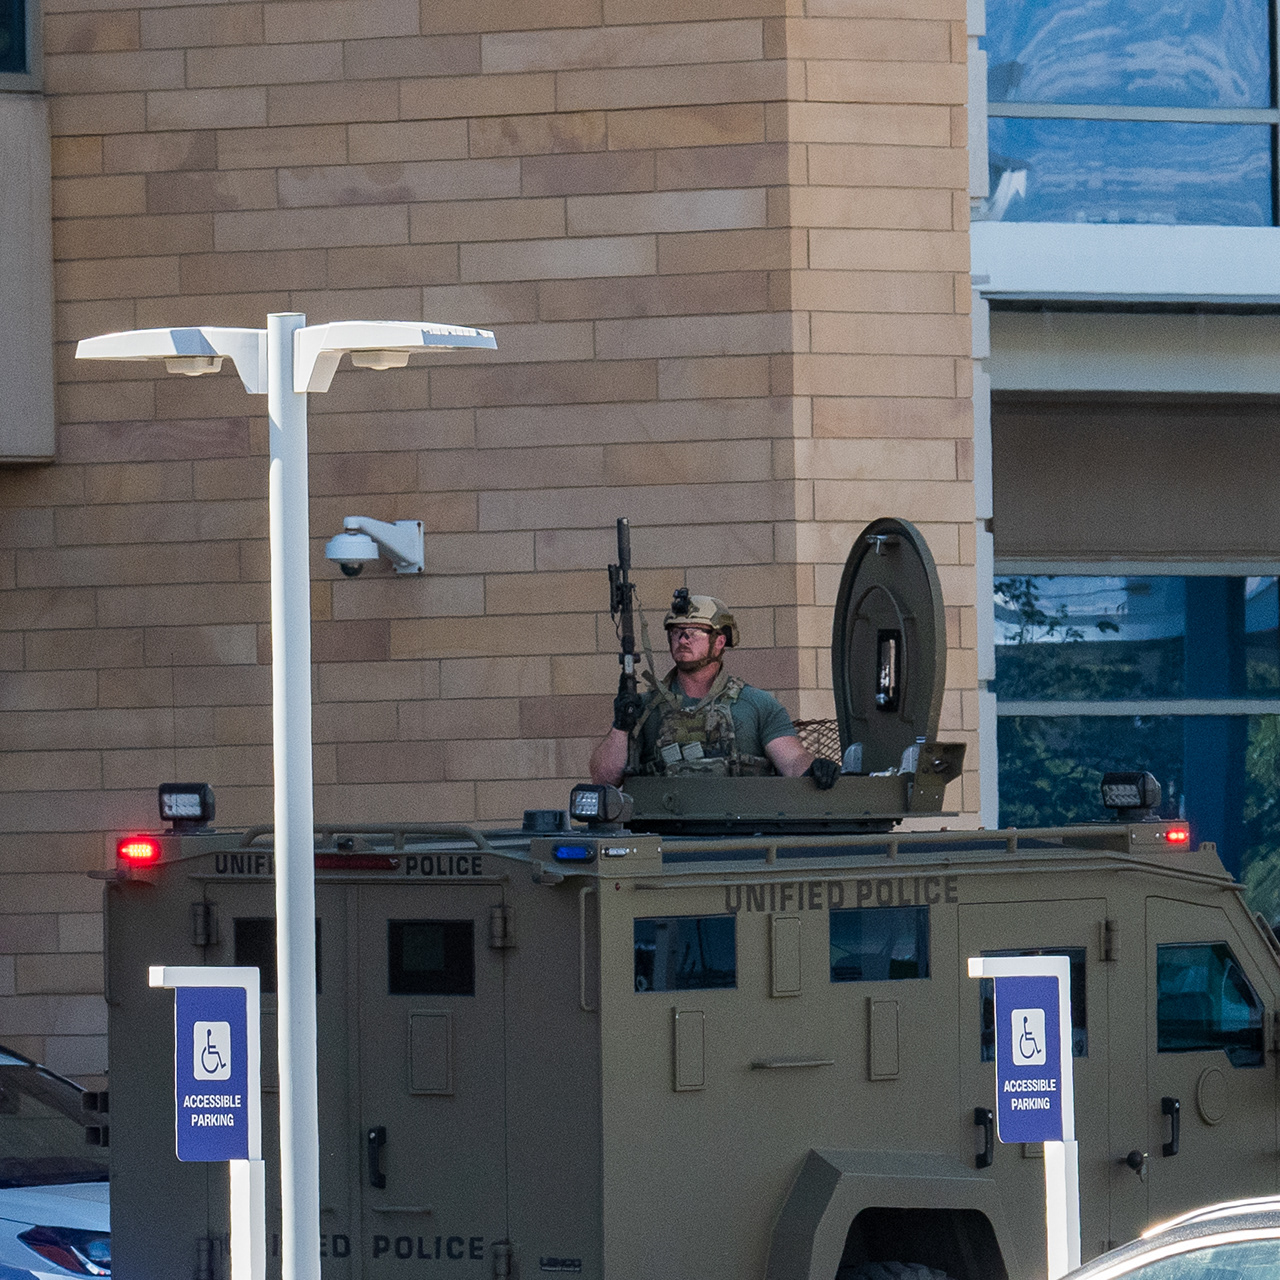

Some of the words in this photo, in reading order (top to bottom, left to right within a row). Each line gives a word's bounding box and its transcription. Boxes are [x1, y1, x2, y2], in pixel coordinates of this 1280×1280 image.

[215, 854, 274, 875] UNIFI
[405, 855, 483, 876] POLICE
[725, 883, 845, 914] UNIFIED
[856, 876, 959, 908] POLICE
[1003, 1079, 1057, 1092] ACCESSIBLE
[183, 1095, 242, 1108] ACCESSIBLE
[1011, 1097, 1050, 1110] PARKING
[191, 1114, 235, 1127] PARKING
[372, 1235, 484, 1260] POLICE
